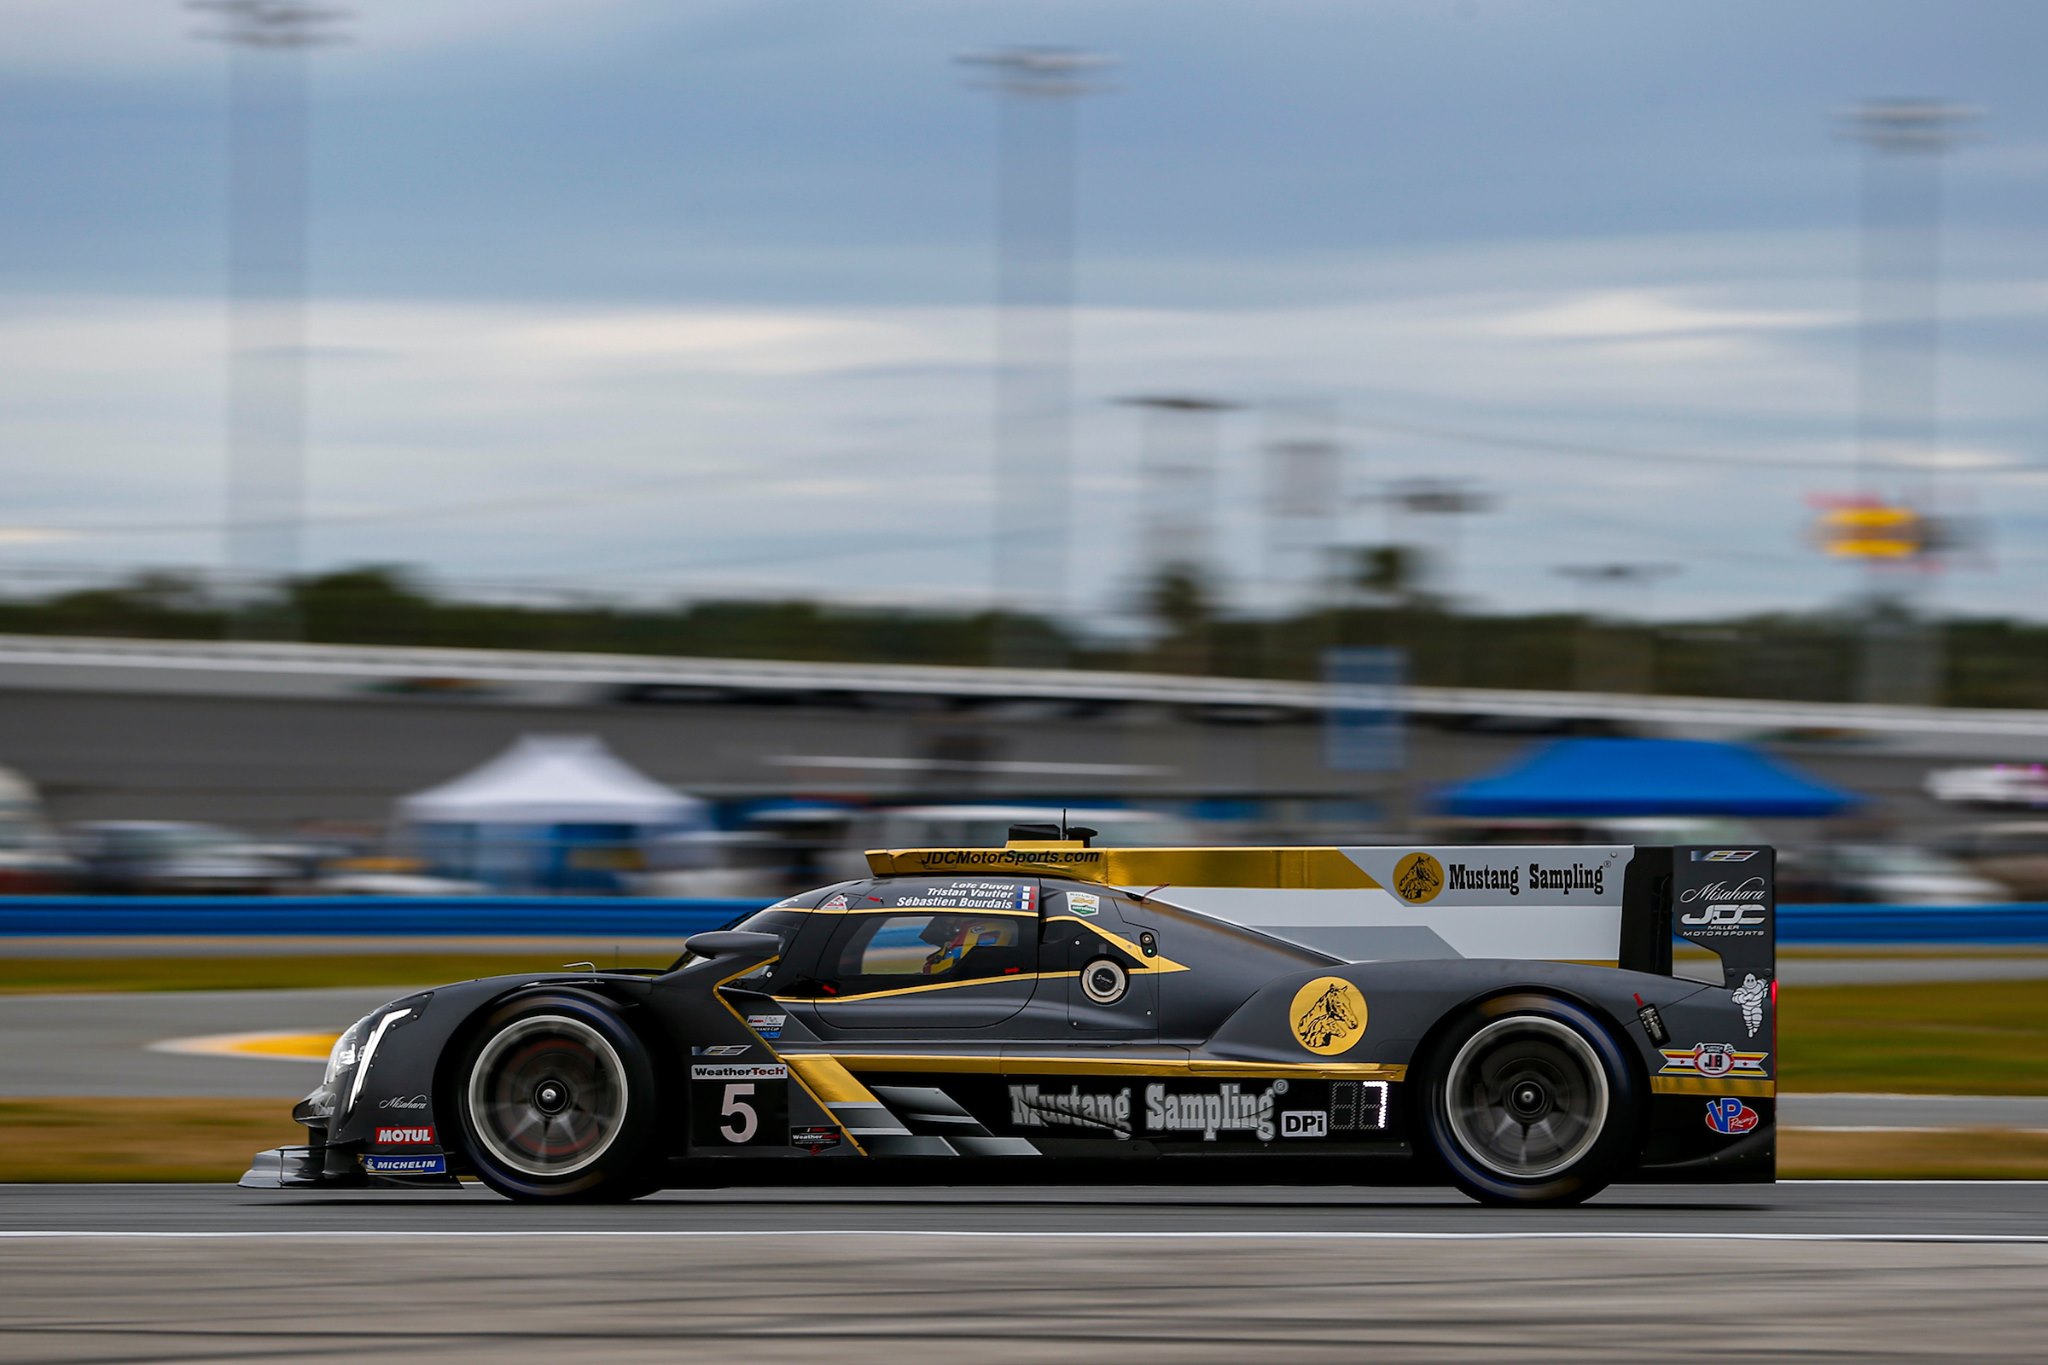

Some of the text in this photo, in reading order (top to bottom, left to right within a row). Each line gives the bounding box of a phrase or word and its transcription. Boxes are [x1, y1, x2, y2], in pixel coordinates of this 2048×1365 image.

[922, 850, 1099, 865] JDCMotorSports.com
[979, 882, 1015, 891] Duval
[1449, 863, 1604, 895] Mustang Sampling
[927, 888, 1014, 899] Tristan Vautier
[1680, 877, 1766, 903] Misahara
[897, 896, 1013, 909] Sébastien Bourdais
[1681, 904, 1766, 924] JDC
[695, 1067, 784, 1076] WeatherTech
[720, 1083, 758, 1143] 5
[1008, 1083, 1275, 1141] Mustang Sampling
[1362, 1081, 1388, 1129] 7
[1285, 1115, 1323, 1132] DPi
[1706, 1098, 1743, 1133] VP
[378, 1129, 431, 1142] MOTUL
[377, 1160, 436, 1169] MICHELIN
